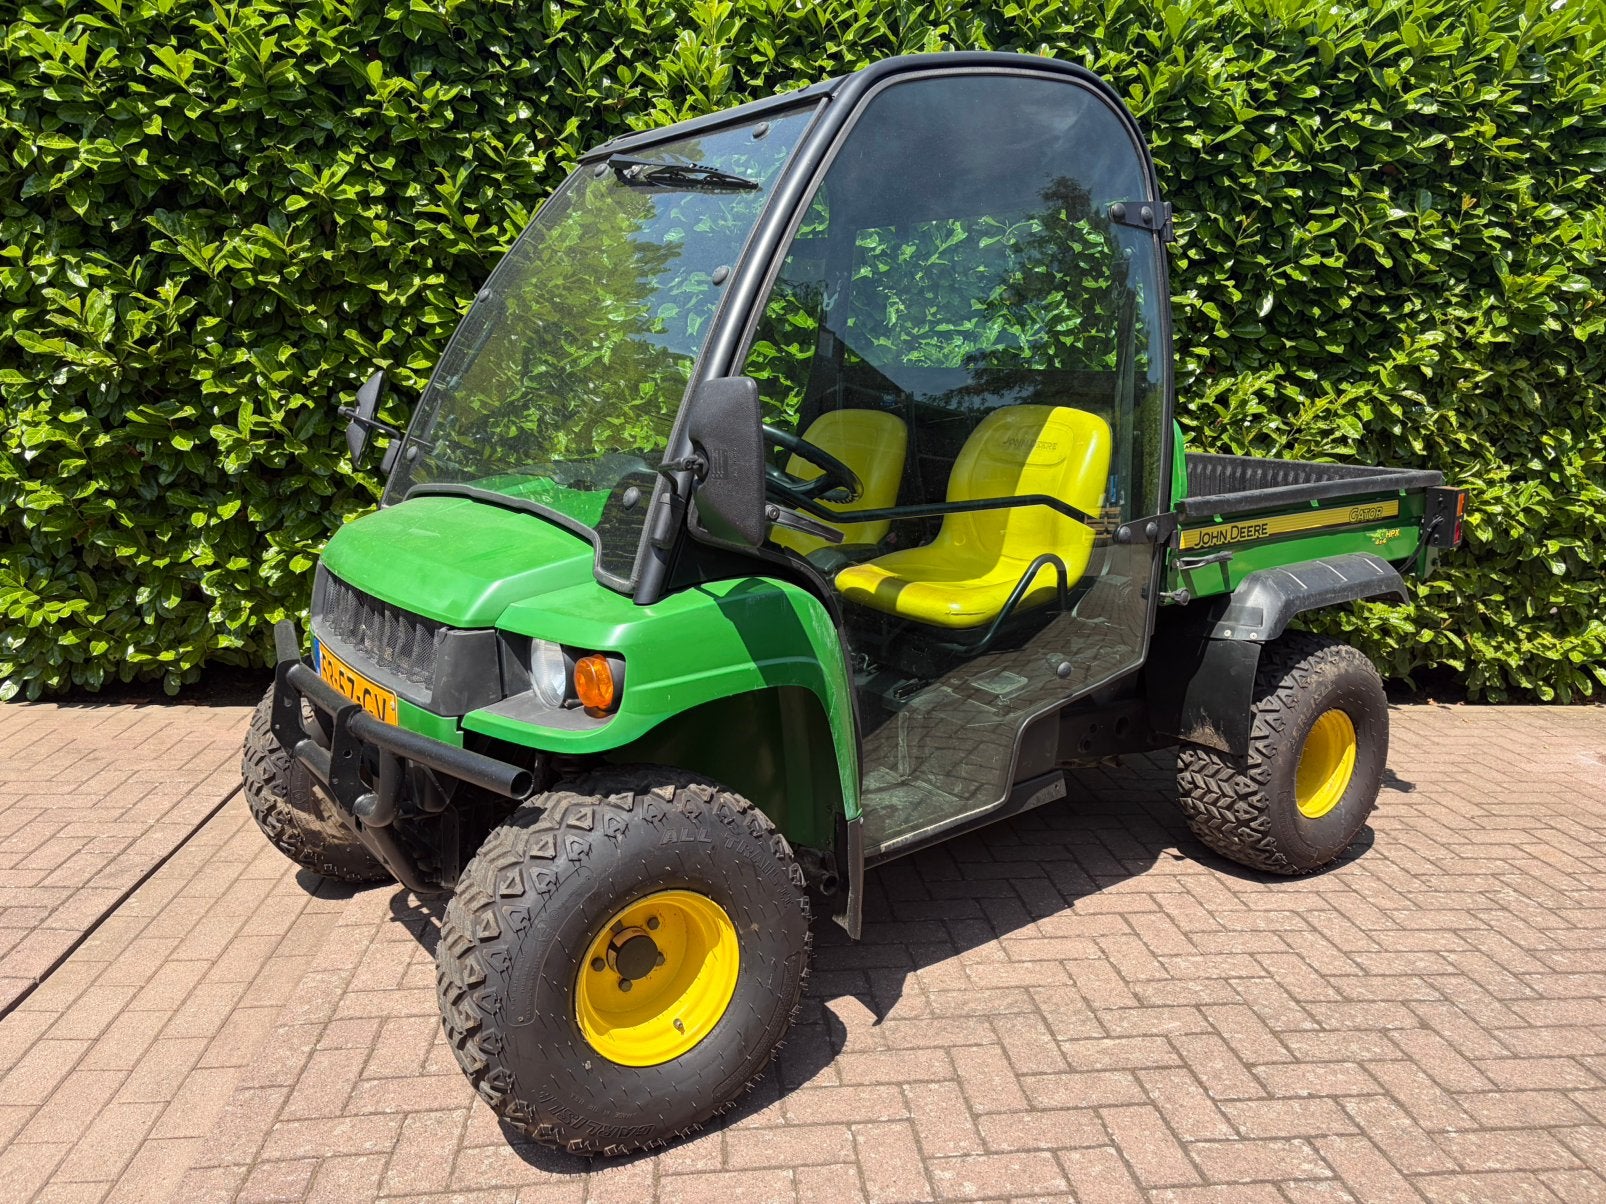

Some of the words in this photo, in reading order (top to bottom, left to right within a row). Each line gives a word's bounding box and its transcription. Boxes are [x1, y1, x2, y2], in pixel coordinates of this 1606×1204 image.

[1194, 530, 1228, 547] JOHN
[1230, 523, 1268, 541] DEERE
[1349, 507, 1384, 523] GATOR
[1386, 528, 1400, 538] HPX
[659, 827, 712, 846] ALL
[721, 831, 782, 886] TRAIL
